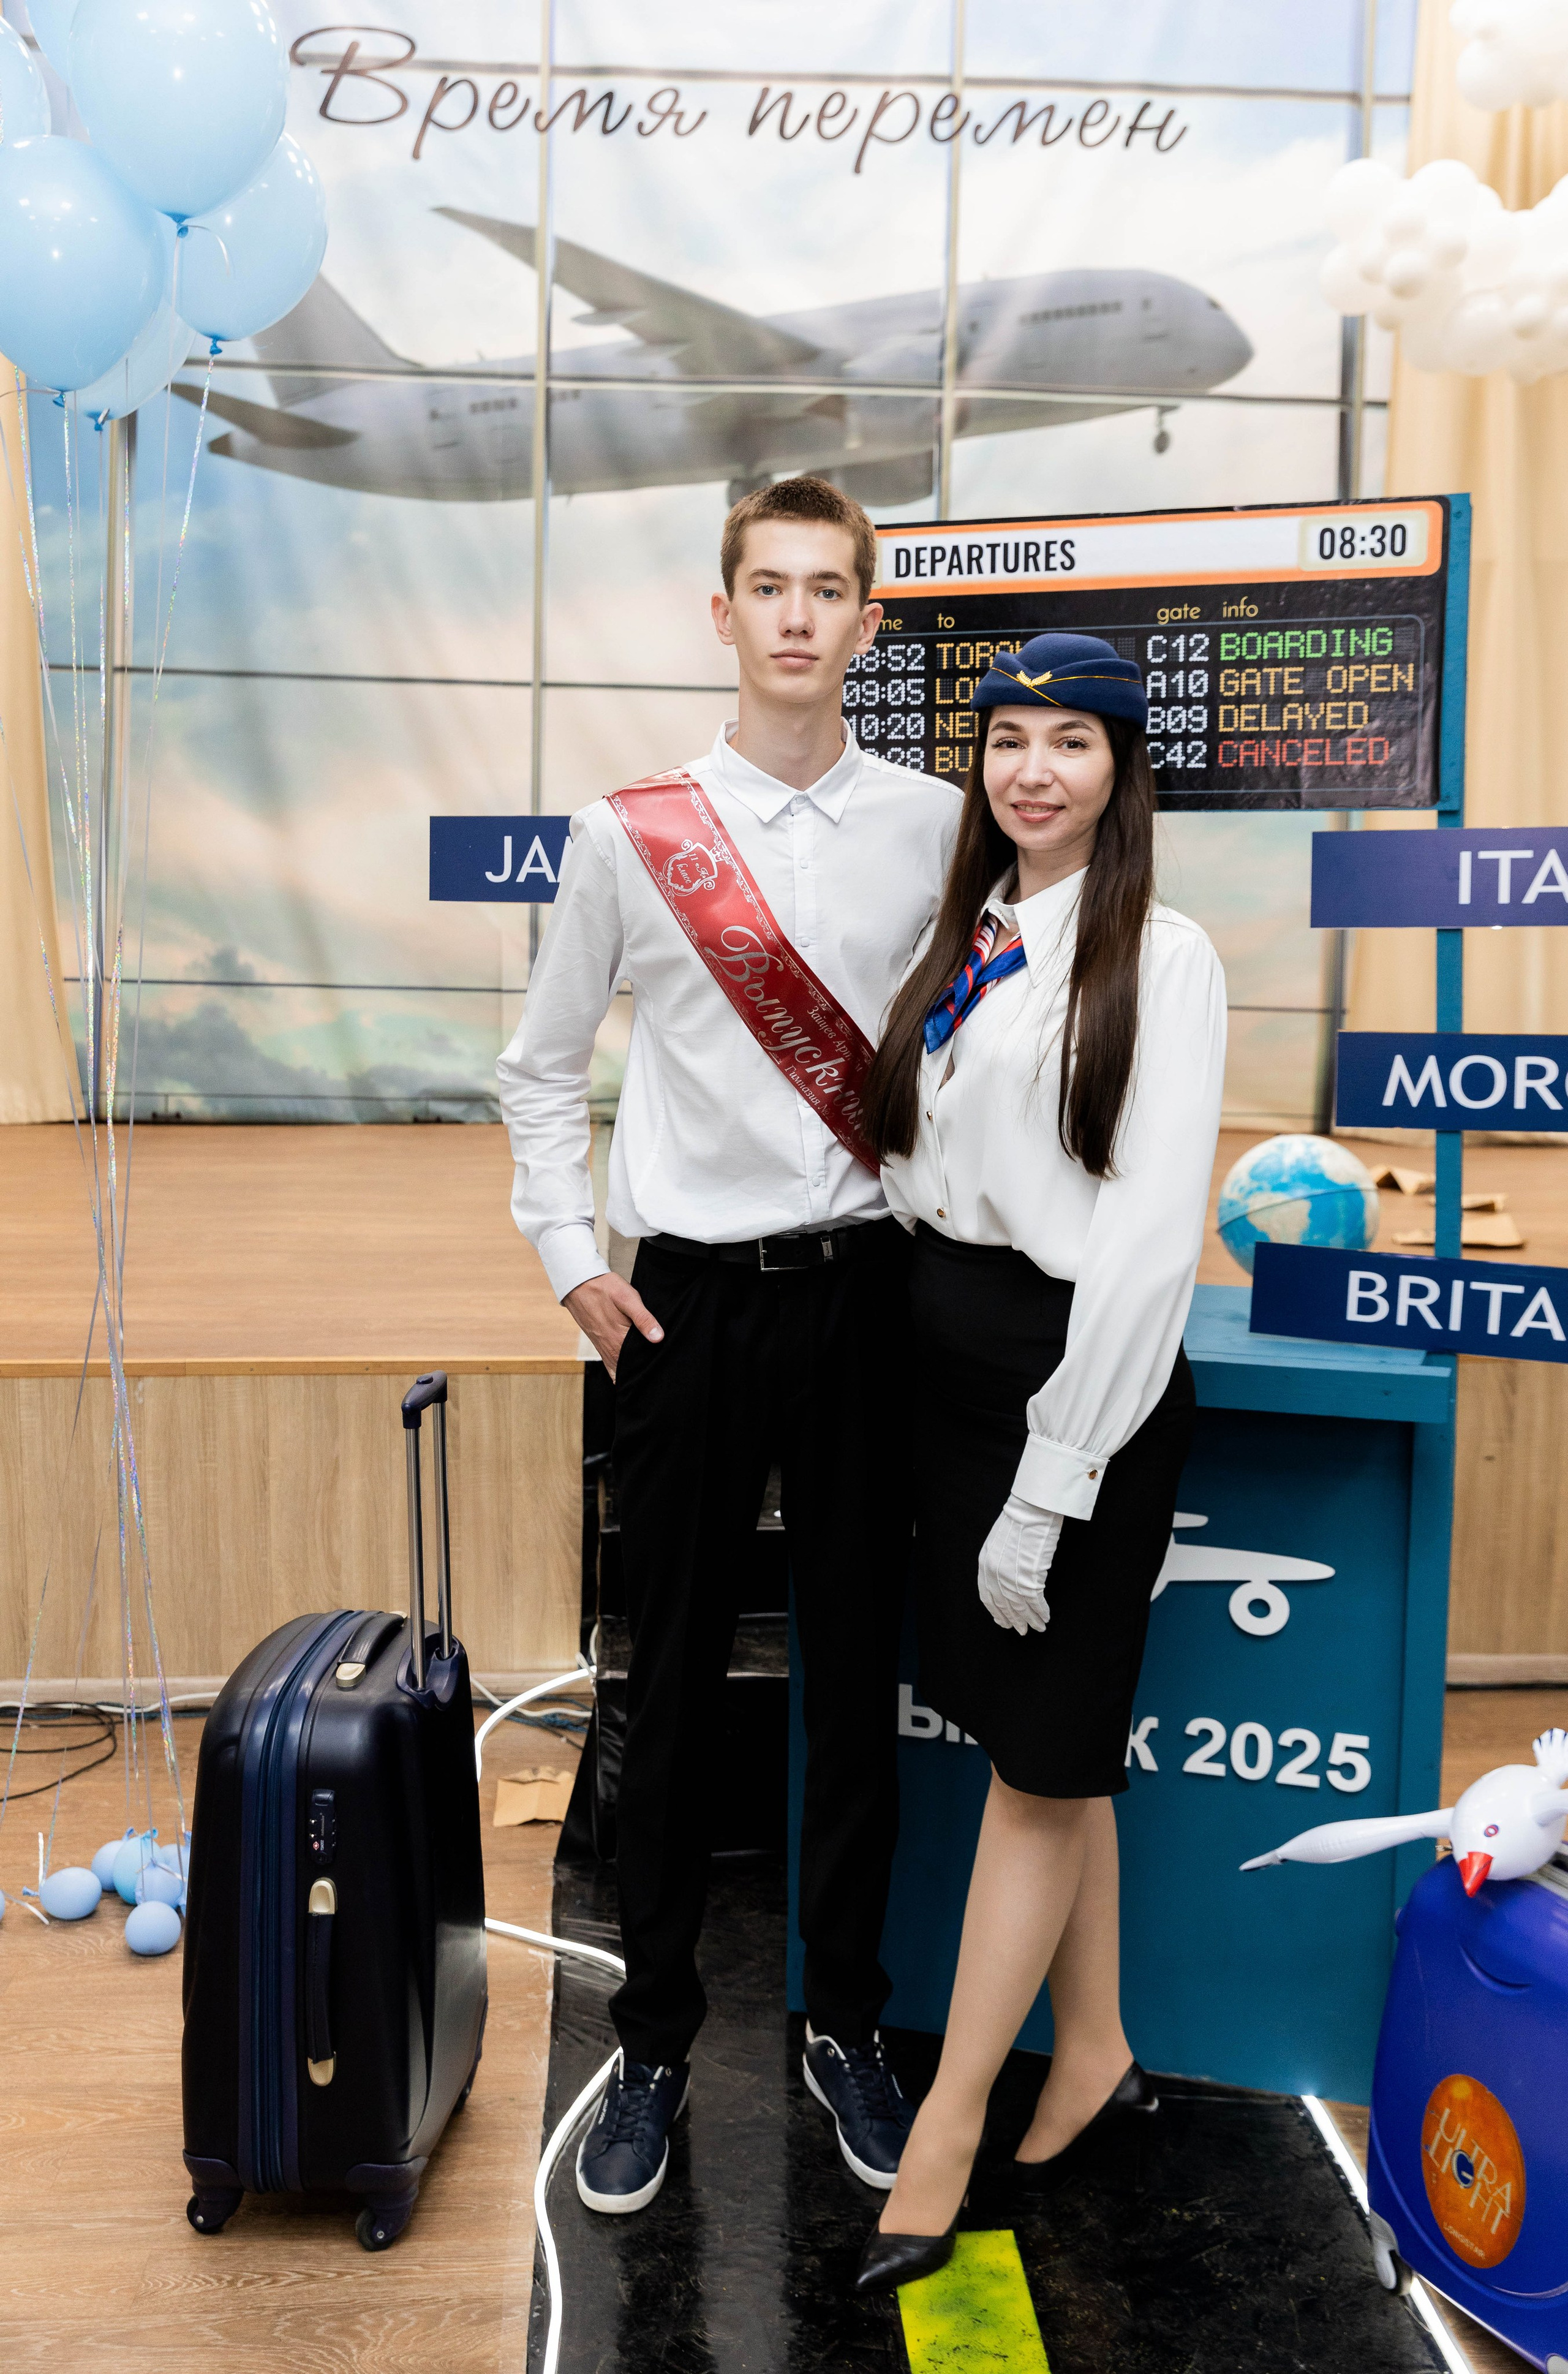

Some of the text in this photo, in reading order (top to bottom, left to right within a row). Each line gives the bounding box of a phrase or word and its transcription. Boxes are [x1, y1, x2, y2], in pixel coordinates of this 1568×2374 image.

[290, 26, 1188, 175] Время перемен
[895, 539, 1076, 578] DEPARTURES
[1319, 524, 1408, 560] 08:30
[937, 613, 955, 629] to
[1156, 602, 1202, 625] gate
[1222, 595, 1259, 618] info
[1147, 632, 1210, 663] C12
[1219, 627, 1393, 662] BOARDING
[842, 663, 1415, 707] 09:05 LO A10 GATE OPEN
[1145, 705, 1208, 735] B09
[1218, 701, 1369, 733] DELAYED
[935, 746, 973, 773] BU
[1147, 740, 1208, 769] C42
[1218, 736, 1390, 768] CANCELED
[676, 863, 692, 884] класс
[688, 853, 699, 861] 11
[1458, 849, 1568, 905] ITA
[807, 1005, 836, 1038] Зайцев
[785, 1065, 821, 1106] Гимназия
[1382, 1054, 1568, 1111] MOR
[1346, 1270, 1567, 1342] BRITA
[1183, 1717, 1371, 1793] 2025
[1439, 2107, 1511, 2215] ULTRA
